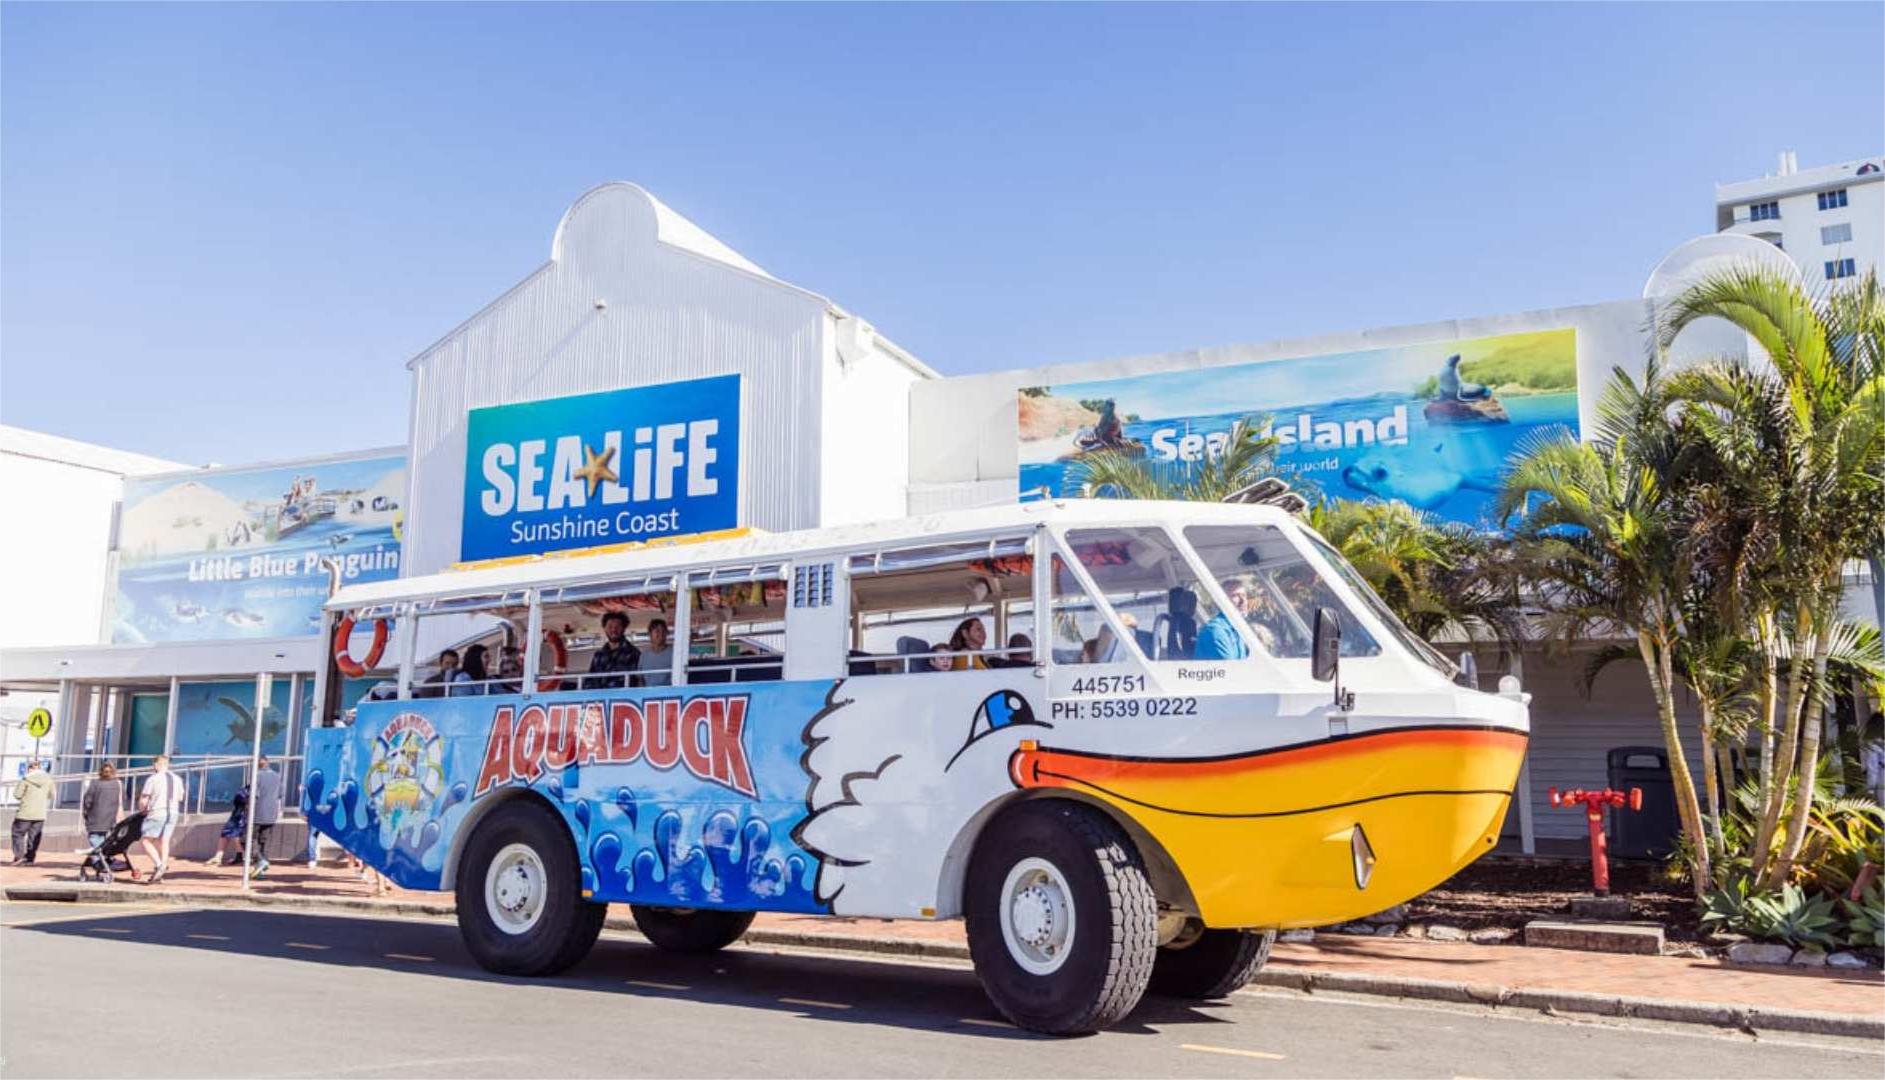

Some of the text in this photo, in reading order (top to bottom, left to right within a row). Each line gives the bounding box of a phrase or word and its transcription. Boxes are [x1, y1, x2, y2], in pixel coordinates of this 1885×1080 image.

[481, 435, 586, 517] SEA
[1301, 457, 1339, 472] world
[511, 508, 680, 544] Sunshine Coast
[188, 556, 243, 582] Little
[249, 555, 298, 578] Blue
[1072, 675, 1146, 695] 445751
[1178, 667, 1226, 681] Reggie
[1051, 697, 1198, 720] PH: 5539 0222
[474, 694, 758, 801] AQUADUCK
